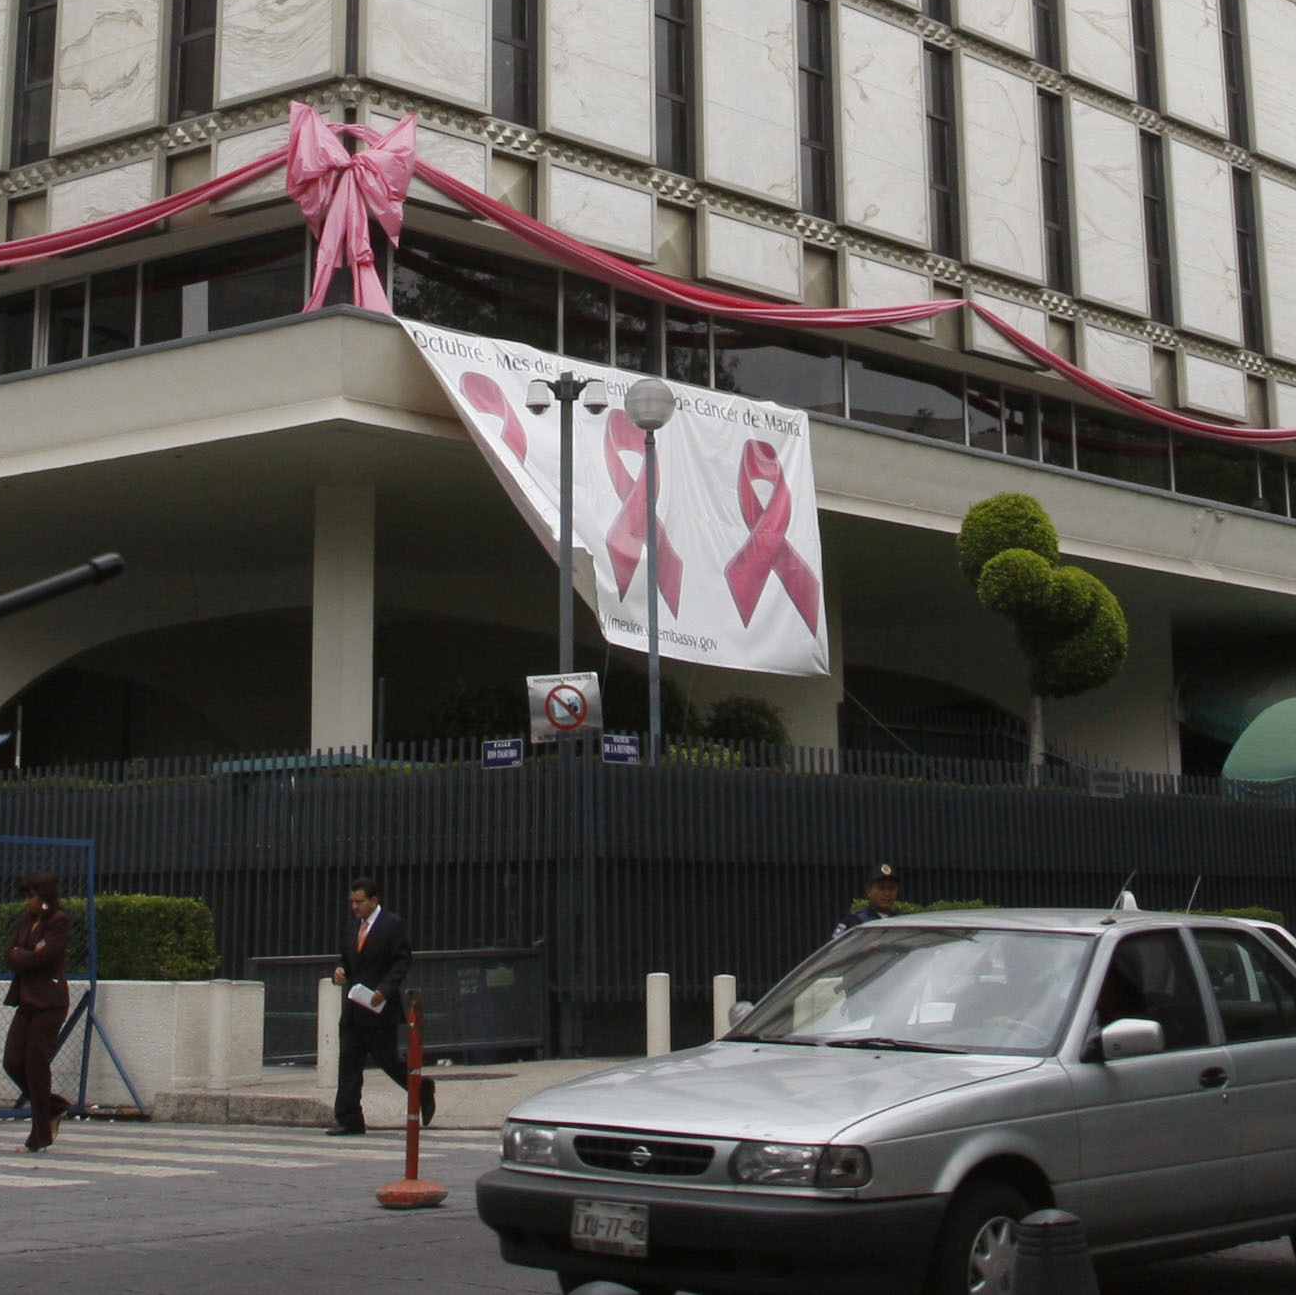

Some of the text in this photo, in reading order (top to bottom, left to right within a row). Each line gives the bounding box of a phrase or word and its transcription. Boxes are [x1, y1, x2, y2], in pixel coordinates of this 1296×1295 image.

[413, 329, 485, 363] Octubre
[496, 353, 531, 372] Mes
[534, 357, 554, 376] de
[695, 398, 739, 424] Cáncer
[742, 408, 760, 428] de
[764, 413, 802, 437] Mama
